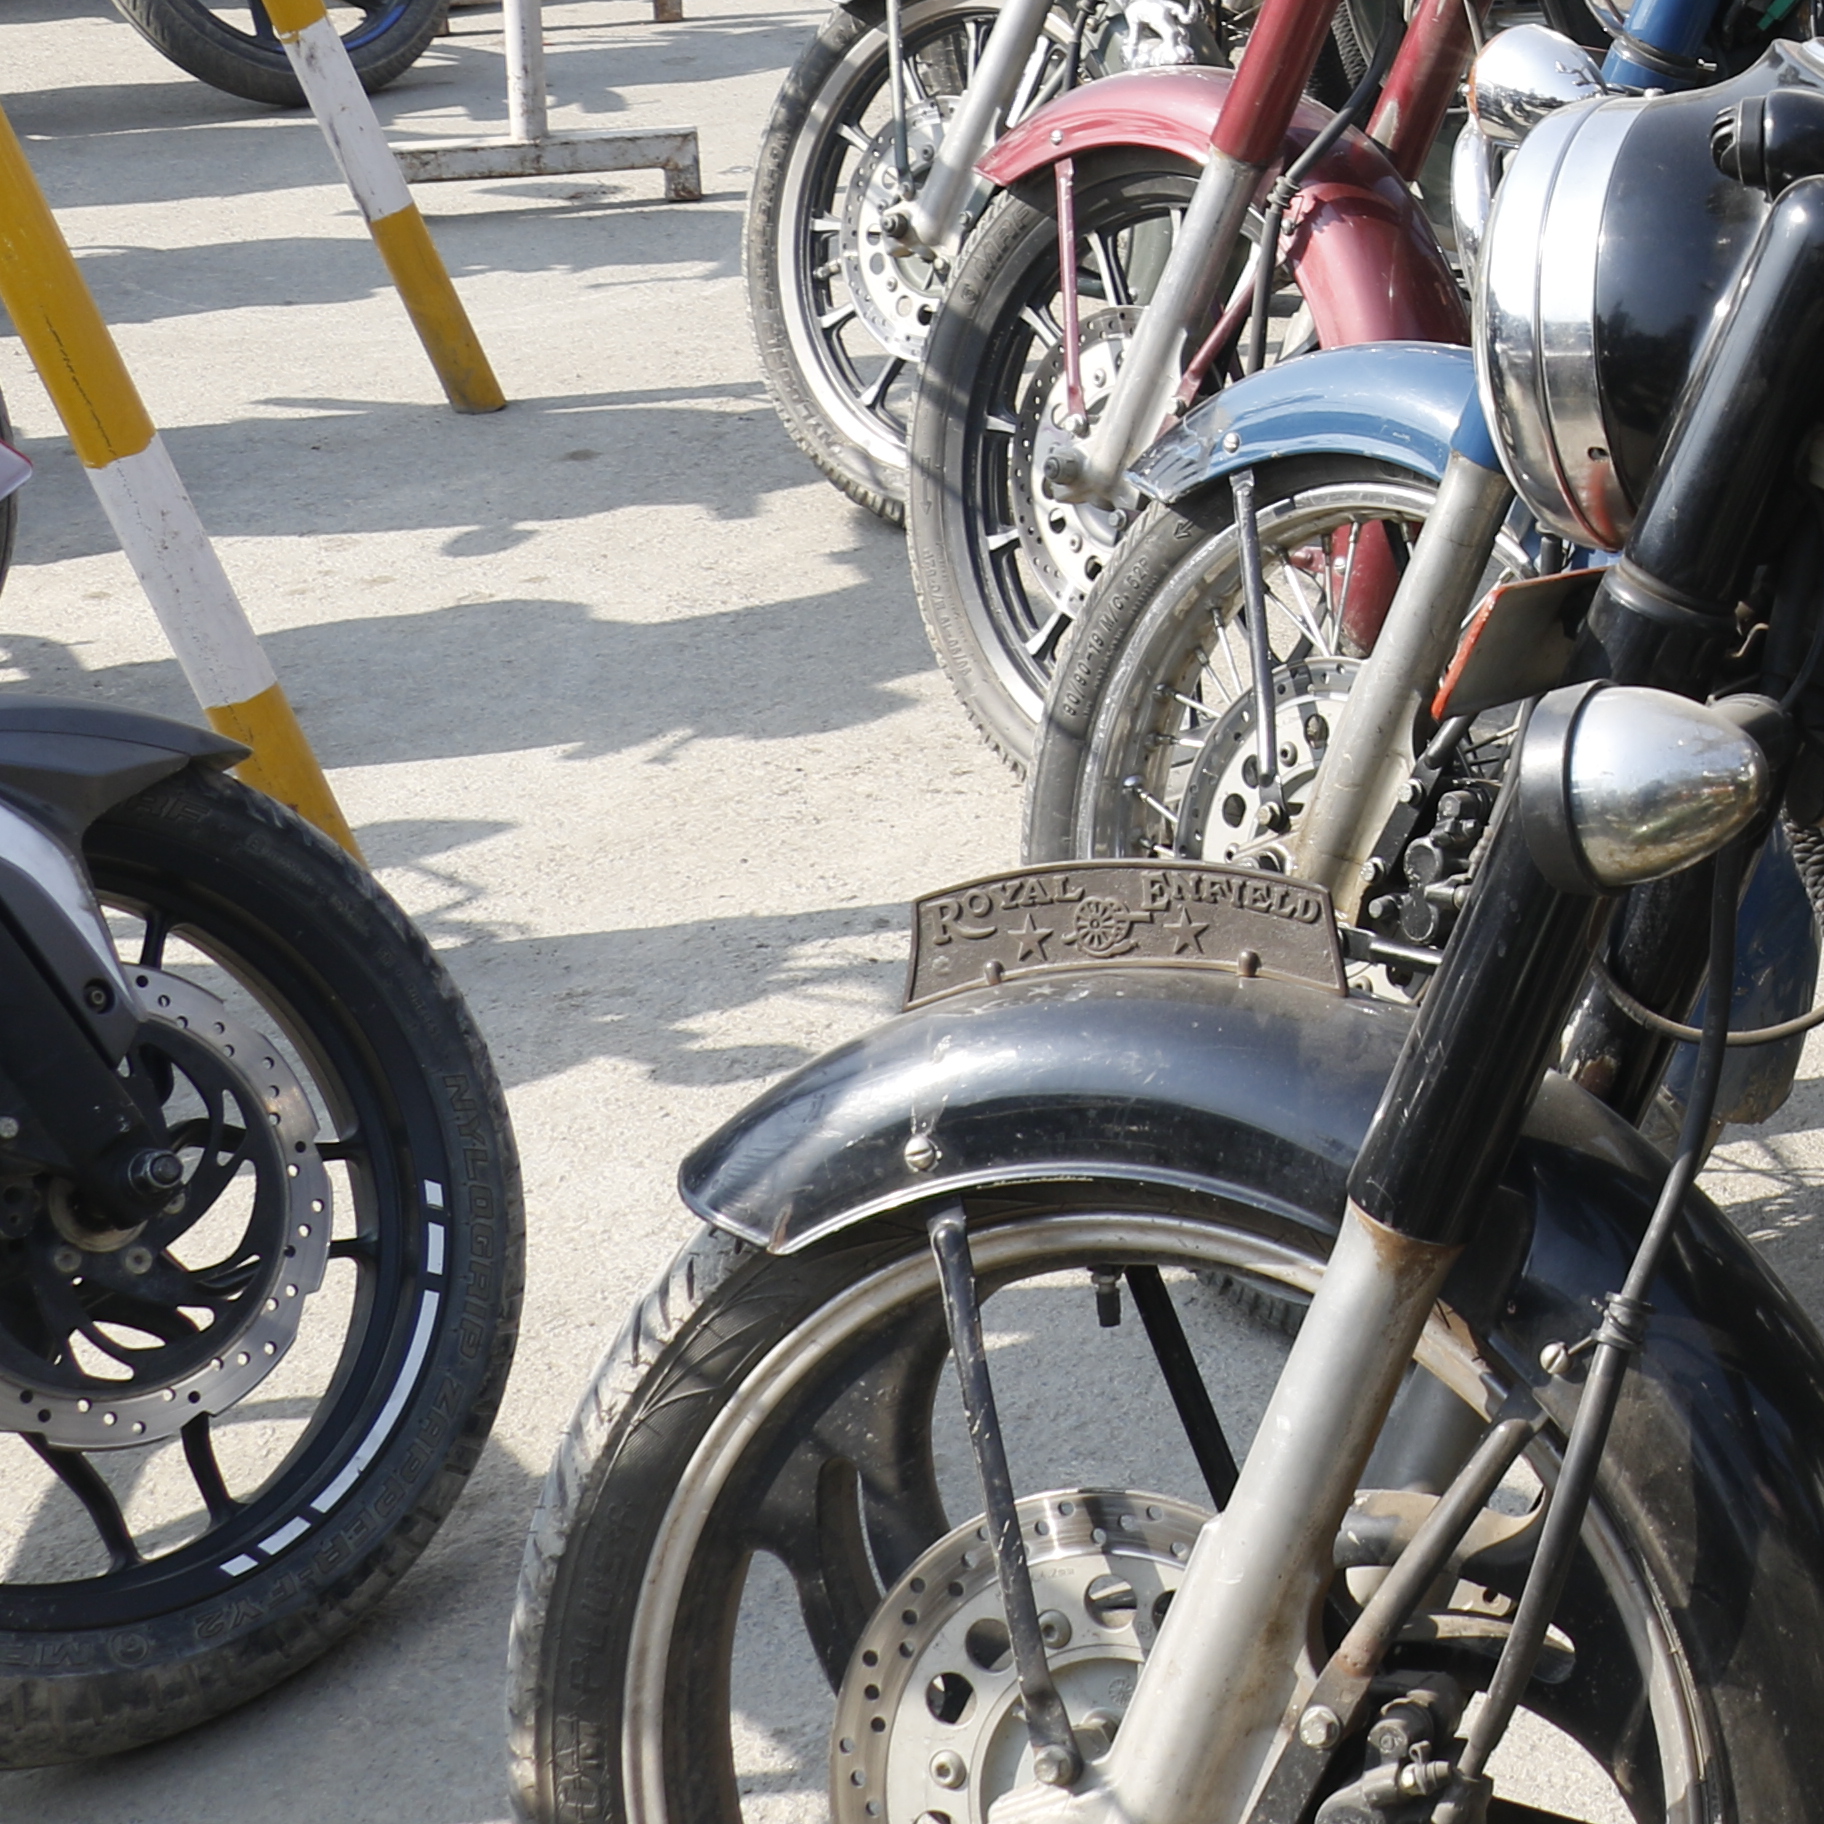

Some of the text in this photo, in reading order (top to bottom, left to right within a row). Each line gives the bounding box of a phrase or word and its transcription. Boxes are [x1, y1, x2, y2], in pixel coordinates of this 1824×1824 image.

[925, 871, 1322, 945] ROYAL ENFIELD
[445, 1074, 494, 1360] NYLOGRIP
